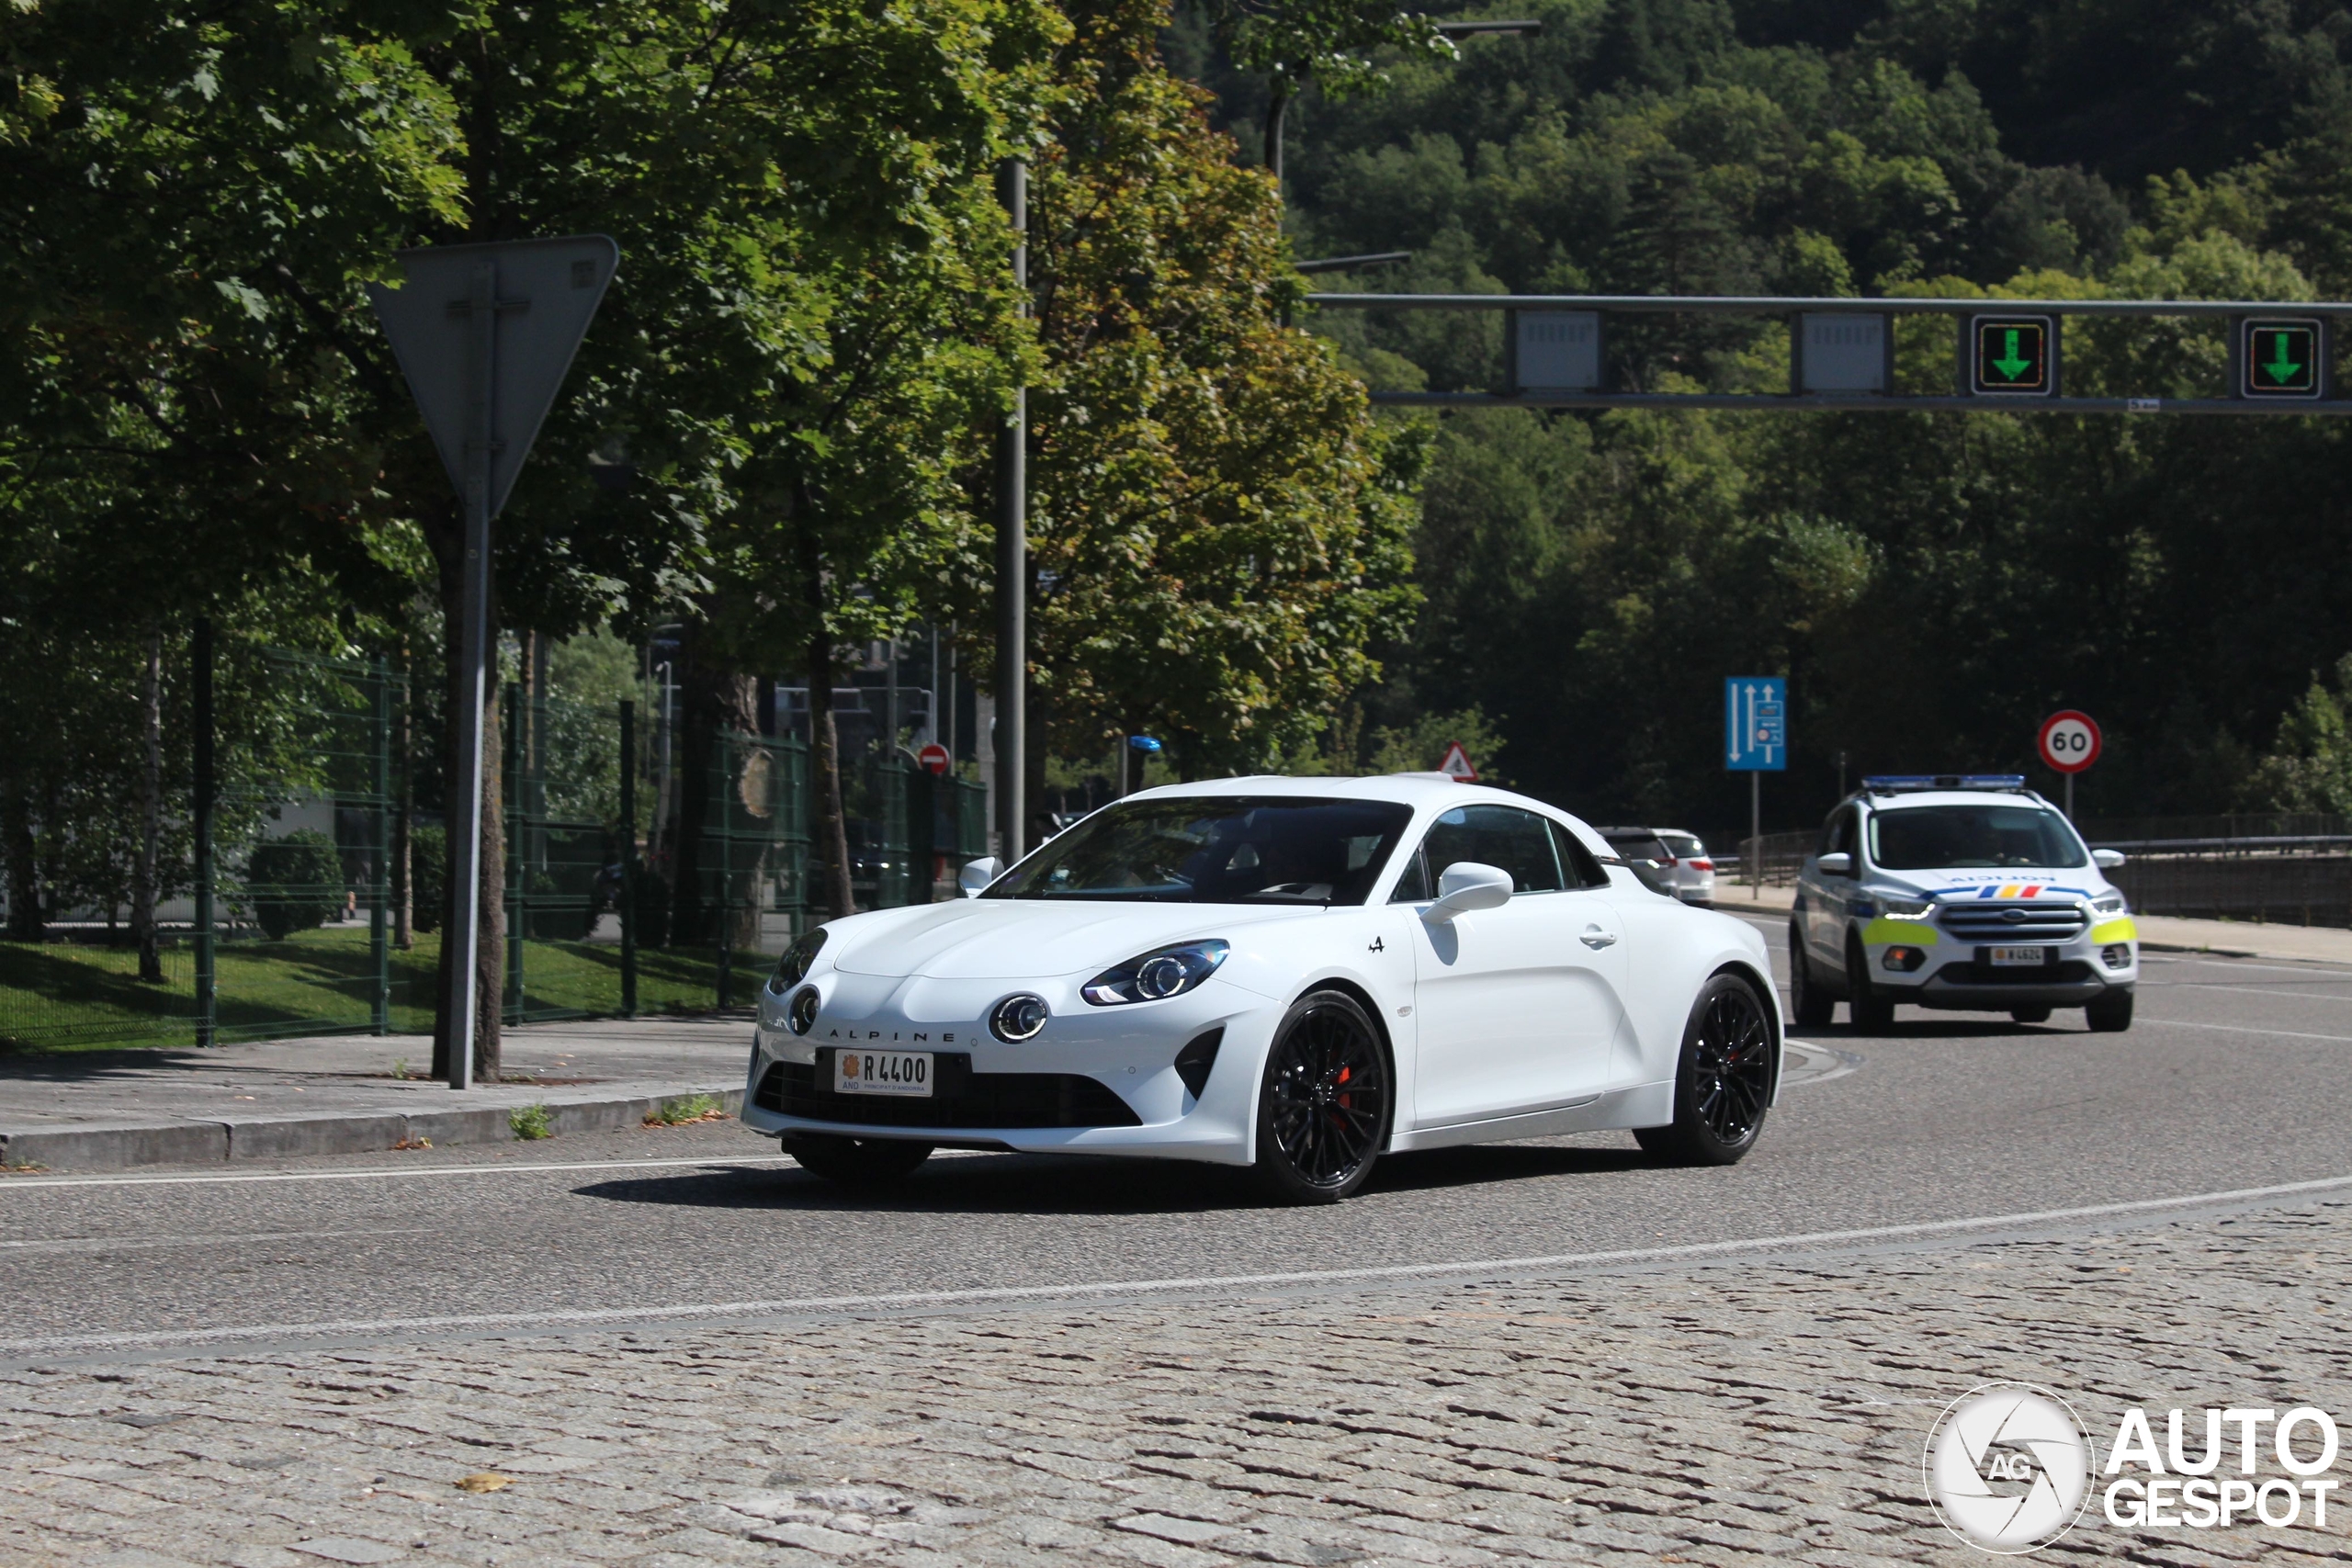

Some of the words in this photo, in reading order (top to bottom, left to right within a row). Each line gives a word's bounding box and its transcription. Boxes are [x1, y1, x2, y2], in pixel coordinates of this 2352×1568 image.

[2052, 732, 2086, 751] 60
[830, 1029, 955, 1042] ALPINE
[865, 1055, 874, 1081] R
[879, 1056, 926, 1083] 4400
[842, 1081, 859, 1090] AND
